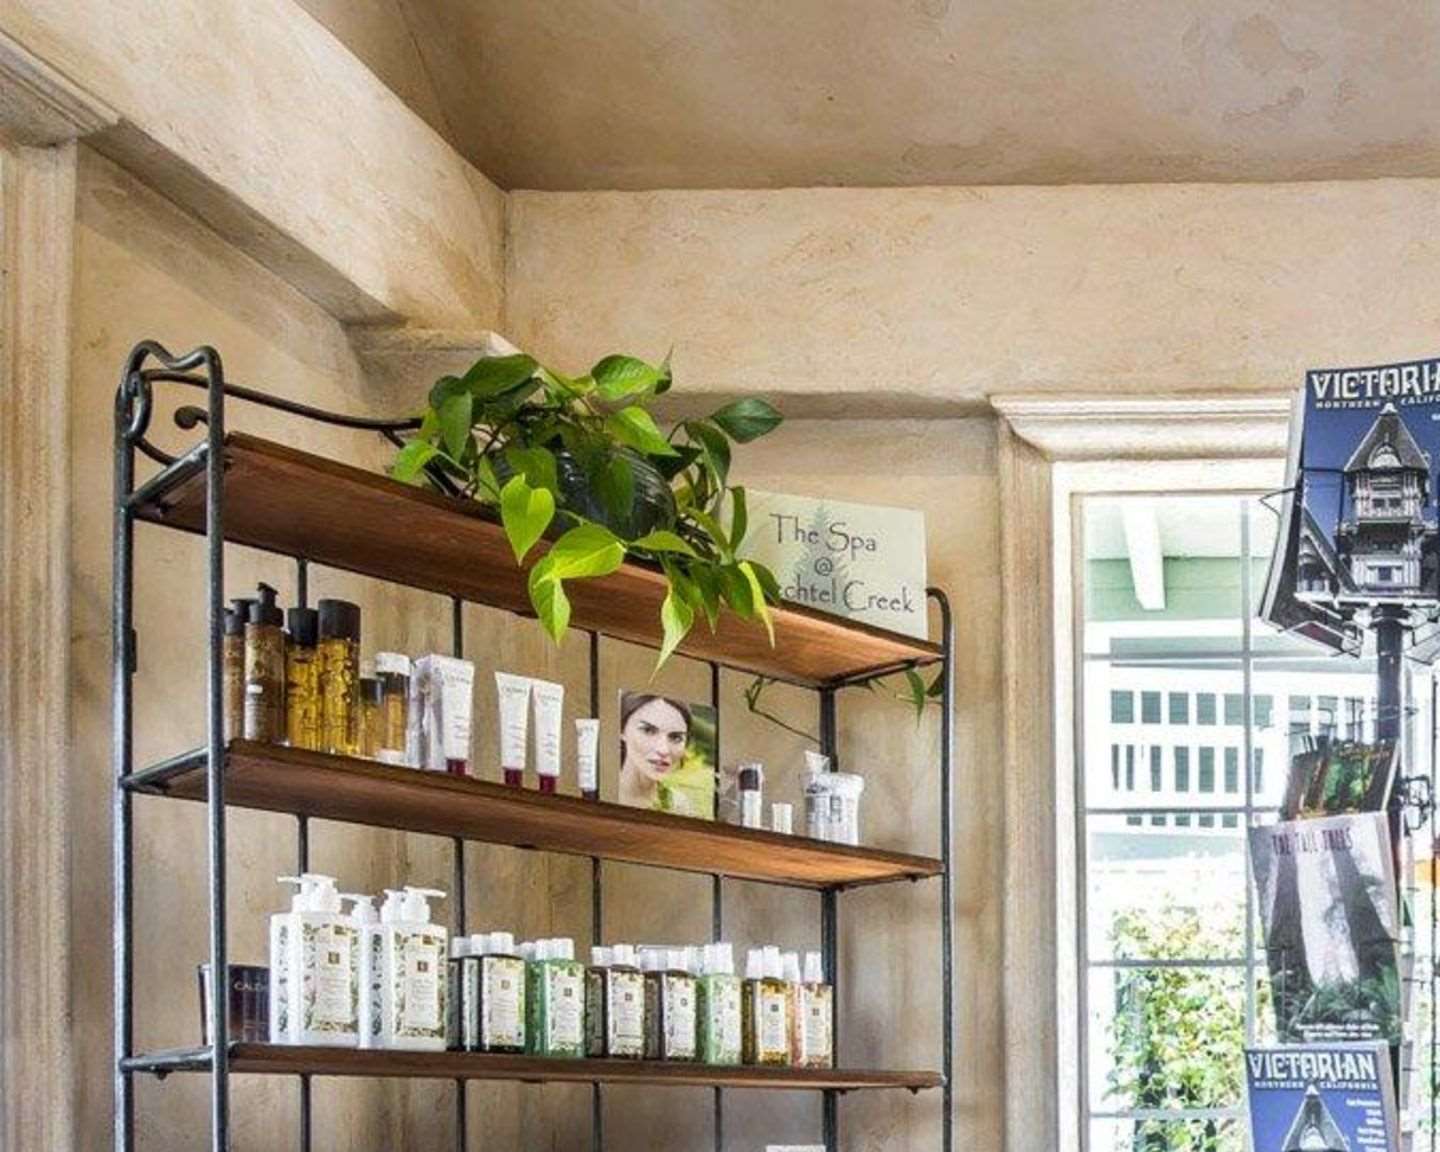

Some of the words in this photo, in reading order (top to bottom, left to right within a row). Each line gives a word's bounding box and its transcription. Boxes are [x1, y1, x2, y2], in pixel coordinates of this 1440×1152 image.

[768, 512, 819, 545] The
[825, 522, 876, 561] Spa
[814, 557, 833, 576] @
[784, 574, 836, 604] chtel
[843, 580, 914, 613] Creek
[1247, 1053, 1377, 1082] VICTORIAN
